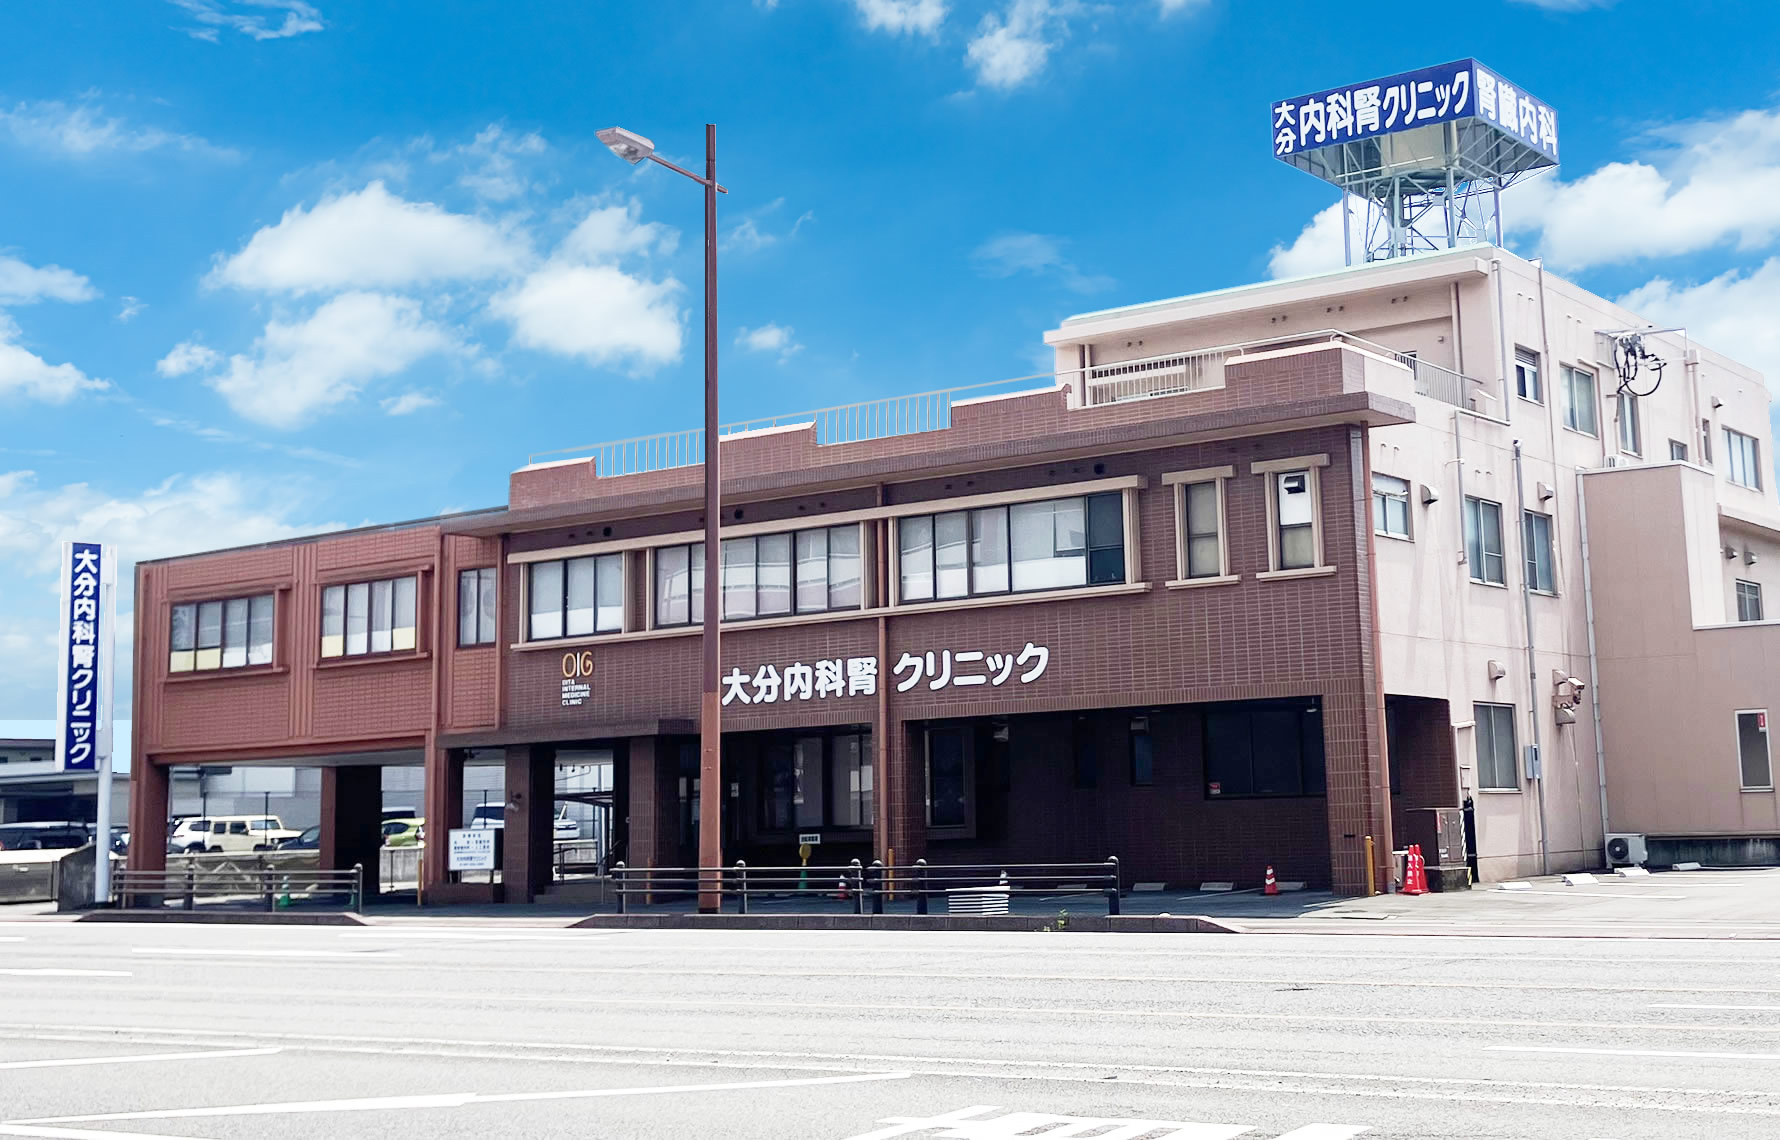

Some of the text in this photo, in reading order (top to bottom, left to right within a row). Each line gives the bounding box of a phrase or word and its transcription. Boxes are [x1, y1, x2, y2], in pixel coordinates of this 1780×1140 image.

[1274, 70, 1470, 155] 大分 内科腎クリニック
[1476, 68, 1558, 156] 腎臓内科
[69, 549, 98, 764] 大分内科腎クリニック
[562, 684, 591, 692] INTERNAL
[562, 691, 590, 699] MEDICINE
[562, 698, 582, 706] CLINIC
